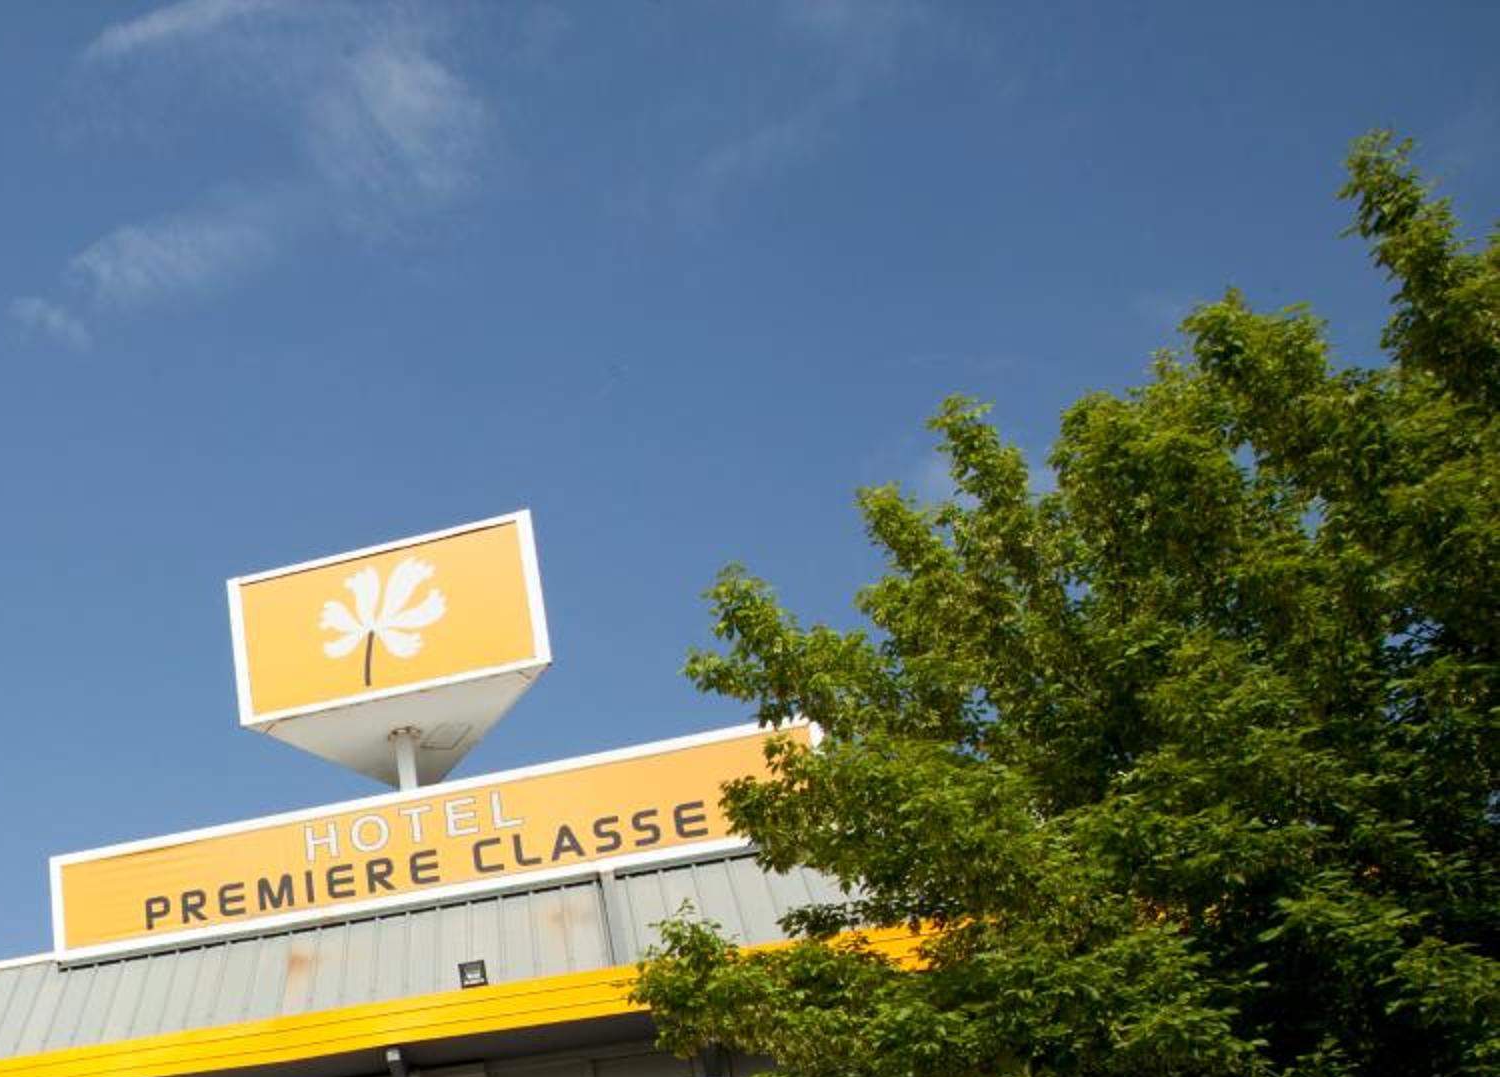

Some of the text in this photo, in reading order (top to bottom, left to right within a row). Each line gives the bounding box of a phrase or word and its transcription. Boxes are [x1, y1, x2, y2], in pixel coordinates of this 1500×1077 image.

[143, 800, 710, 931] PREMIERE CLASSE
[304, 790, 525, 863] HOTEL
